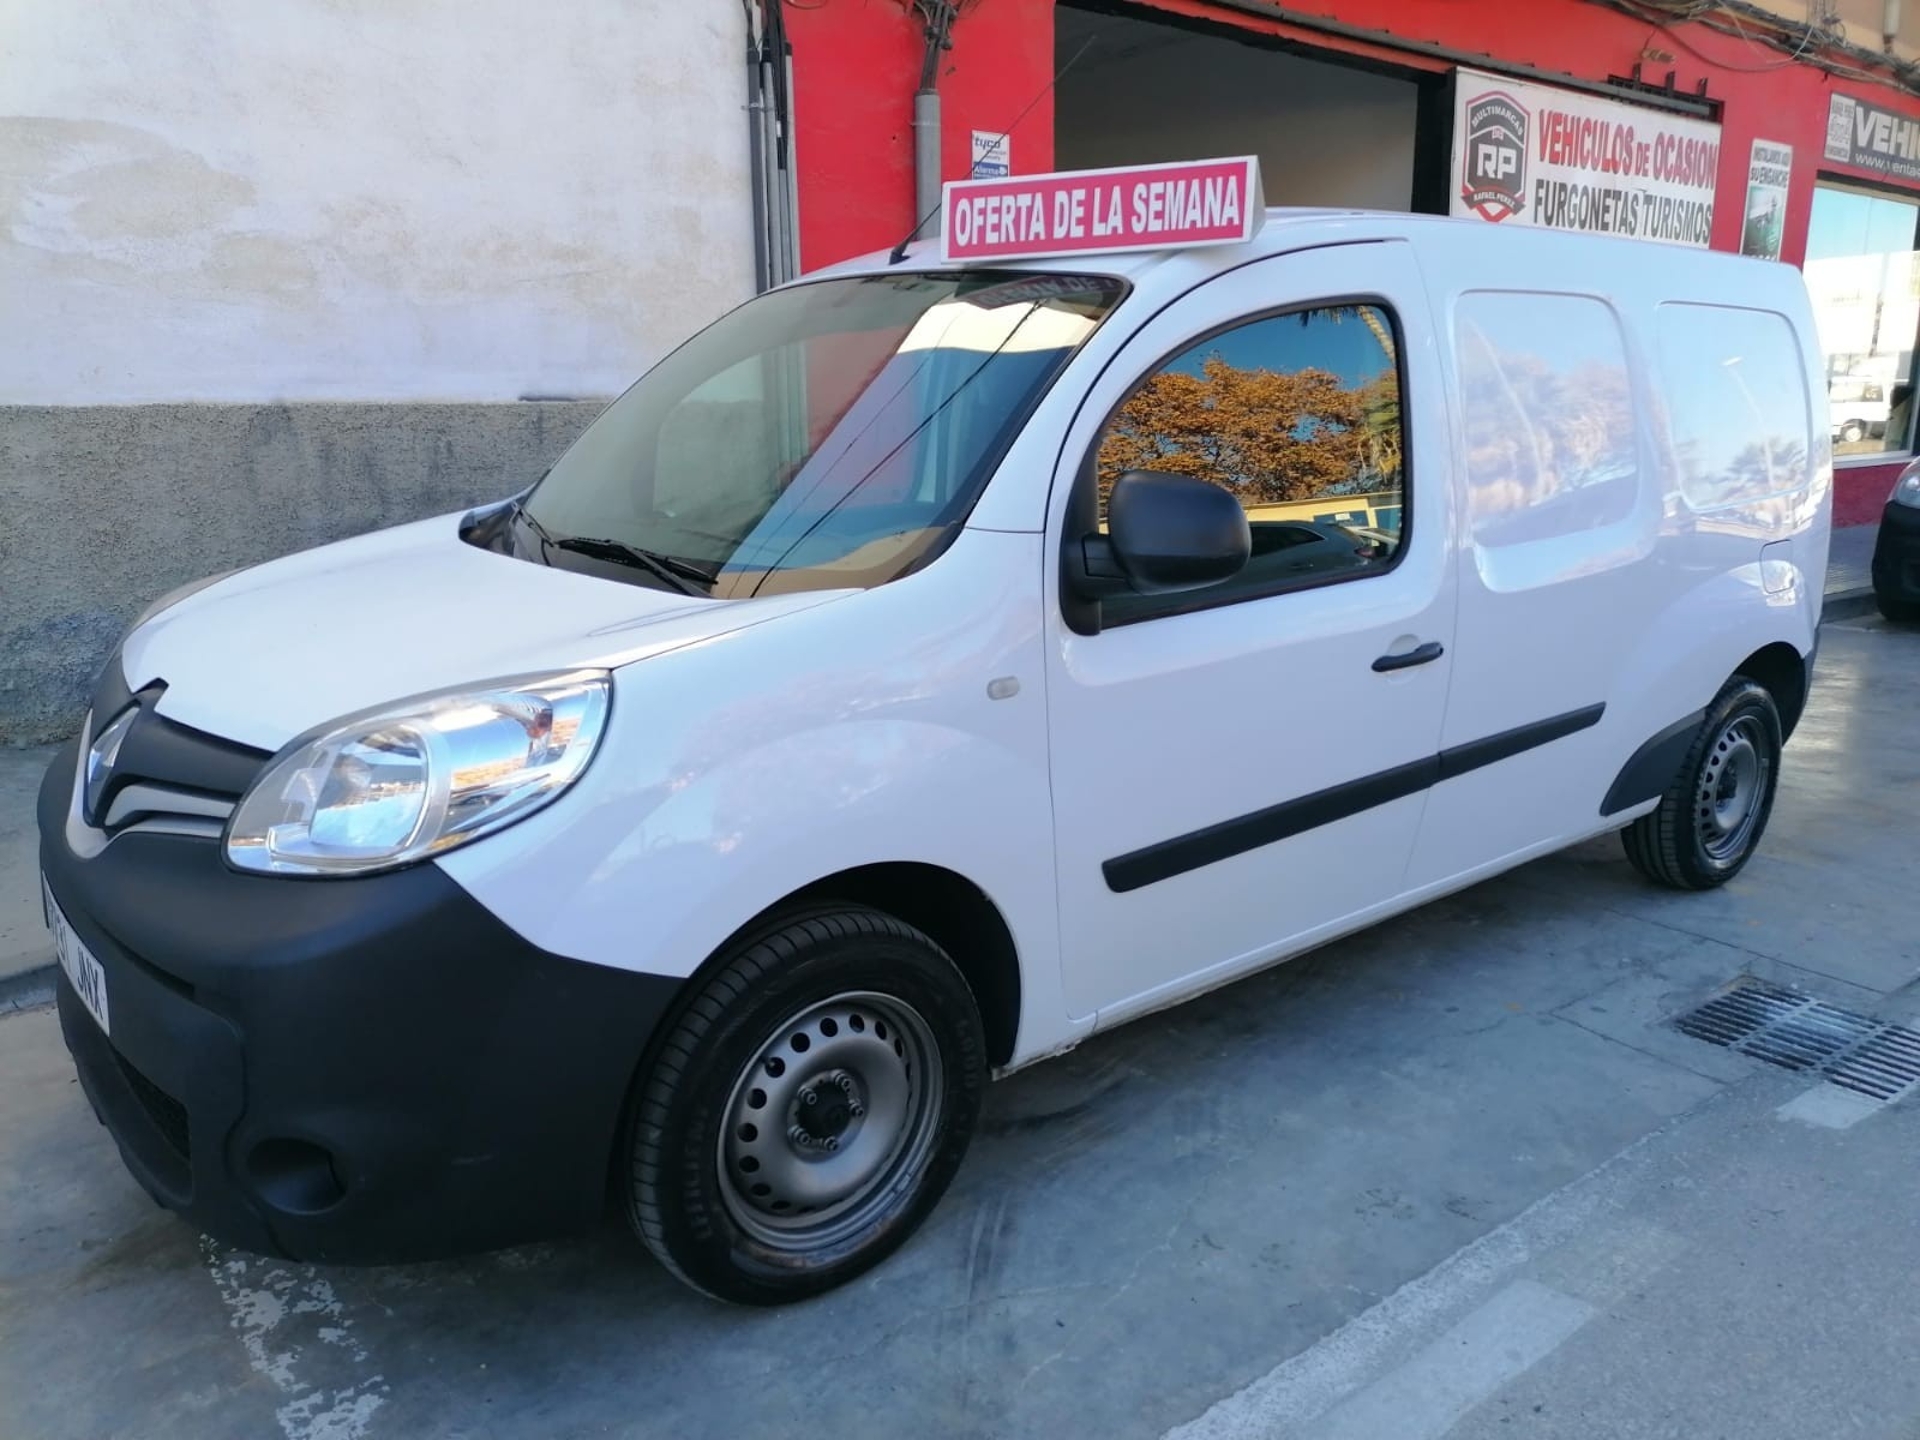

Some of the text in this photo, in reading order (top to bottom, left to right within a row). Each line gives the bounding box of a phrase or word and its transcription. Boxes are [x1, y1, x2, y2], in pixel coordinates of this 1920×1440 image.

[974, 137, 1001, 150] tyco
[1471, 105, 1524, 136] MULTIMARCAS
[1855, 105, 1920, 161] VEHI
[1476, 143, 1517, 180] RP
[1538, 108, 1719, 190] VEHICULOS DE OCASION
[954, 175, 1240, 247] OFERTA DE LA SEMANA
[1533, 178, 1713, 244] FURGONETAS TURISMOS
